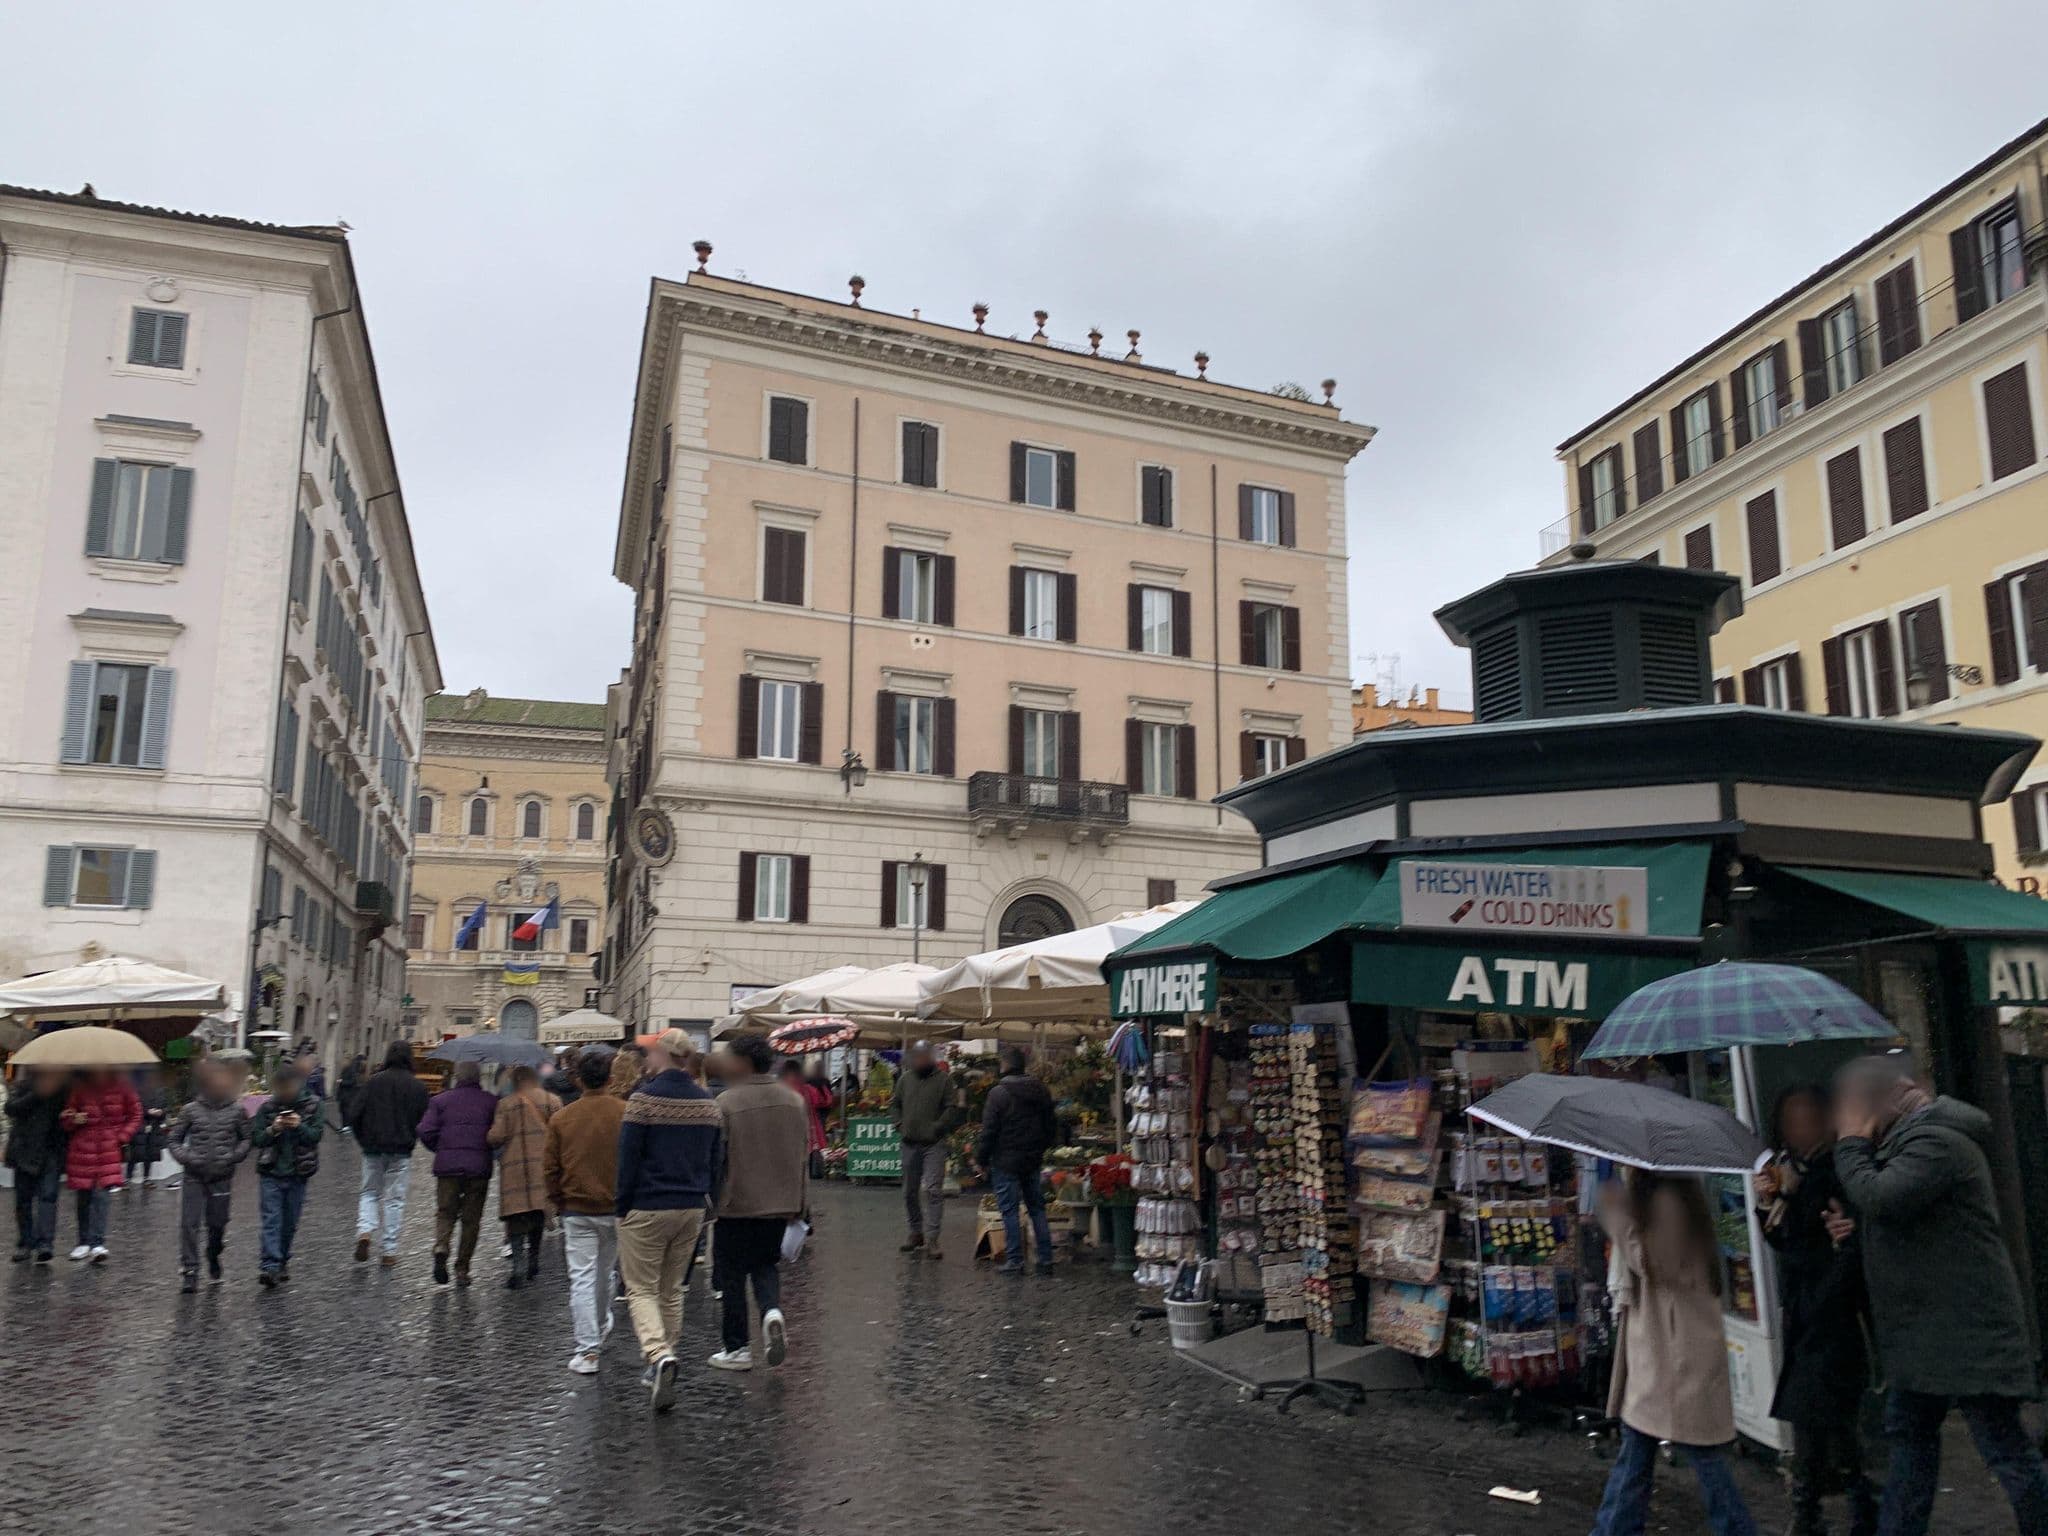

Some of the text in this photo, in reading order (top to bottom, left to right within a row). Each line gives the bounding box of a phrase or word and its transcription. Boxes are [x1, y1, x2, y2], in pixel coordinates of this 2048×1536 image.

[1415, 868, 1552, 898] FRESH WATER
[1480, 900, 1614, 929] COLD DRINKS
[1118, 963, 1207, 1013] ATM HERE
[1447, 956, 1588, 1010] ATM
